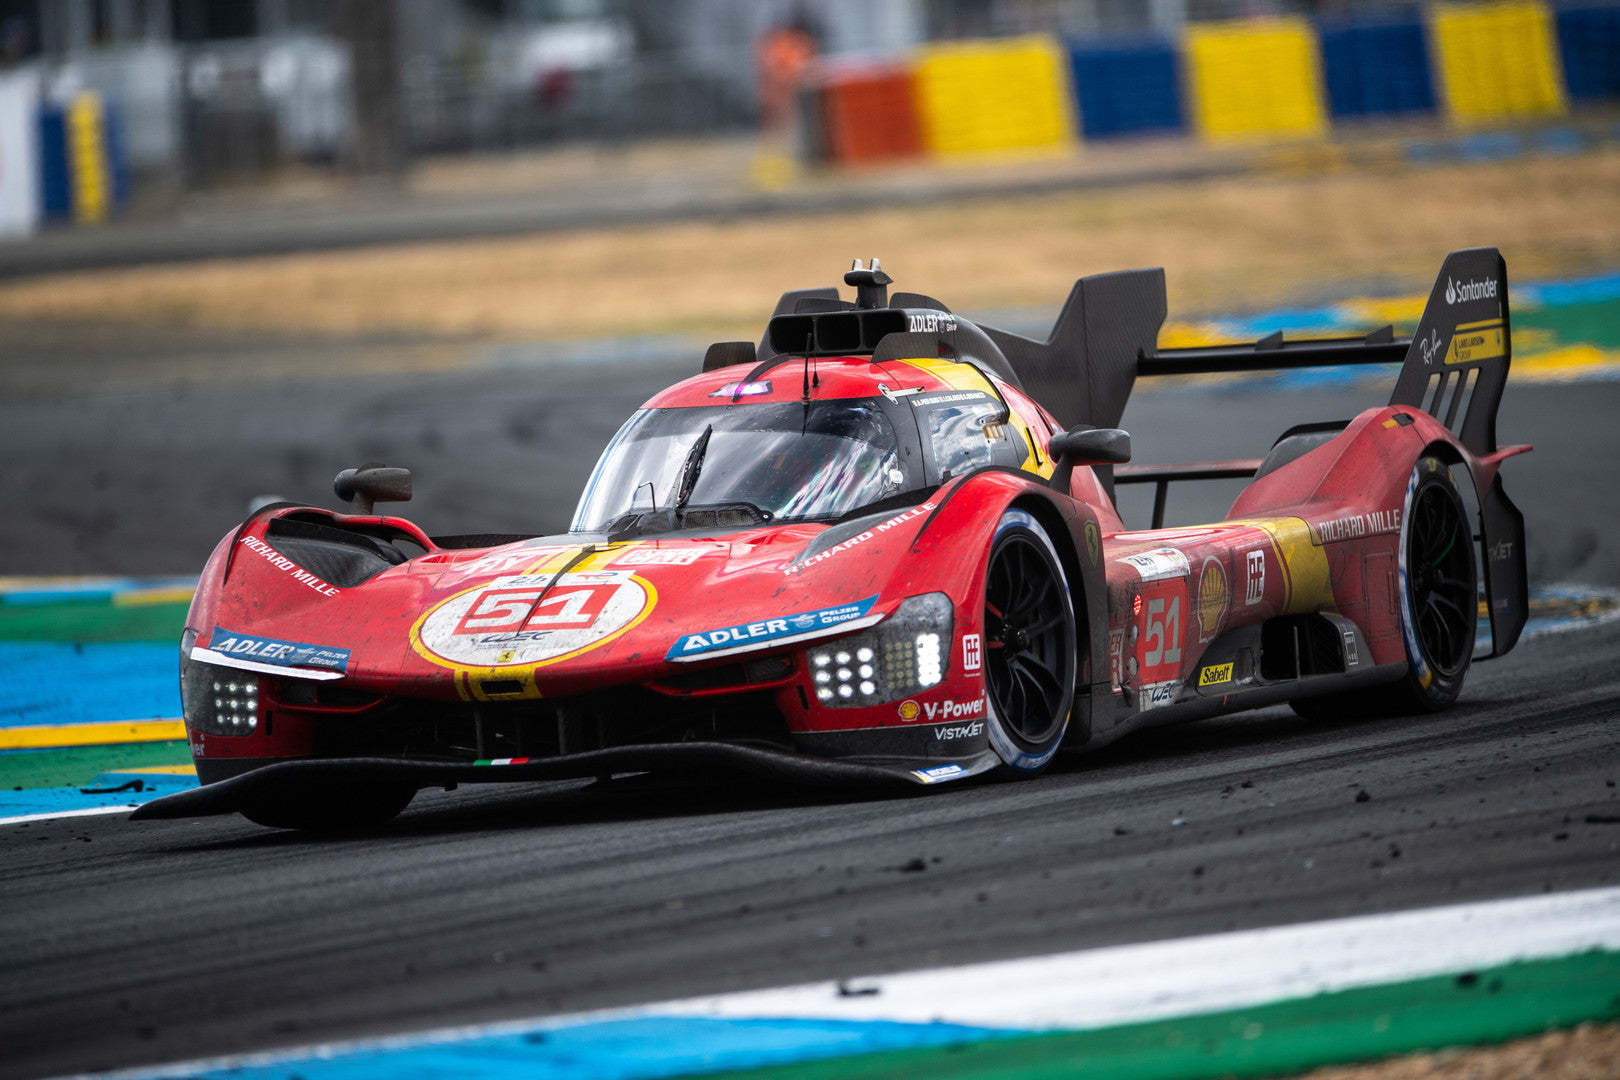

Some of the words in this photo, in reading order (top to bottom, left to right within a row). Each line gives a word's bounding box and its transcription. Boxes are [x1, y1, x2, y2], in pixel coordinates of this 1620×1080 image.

[1456, 277, 1498, 303] Santander
[910, 314, 938, 332] ADLER
[877, 502, 936, 532] MILLE
[1319, 515, 1366, 541] RICHARD
[1366, 509, 1400, 533] MILLE
[240, 535, 294, 571] RICHARD
[290, 567, 340, 597] MILLE
[464, 590, 595, 628] 51
[821, 612, 861, 624] GROUP
[683, 619, 788, 650] ADLER
[1145, 595, 1181, 667] 51
[210, 638, 295, 659] ADLER
[1203, 665, 1230, 683] Sabelt
[924, 699, 984, 720] V-Power
